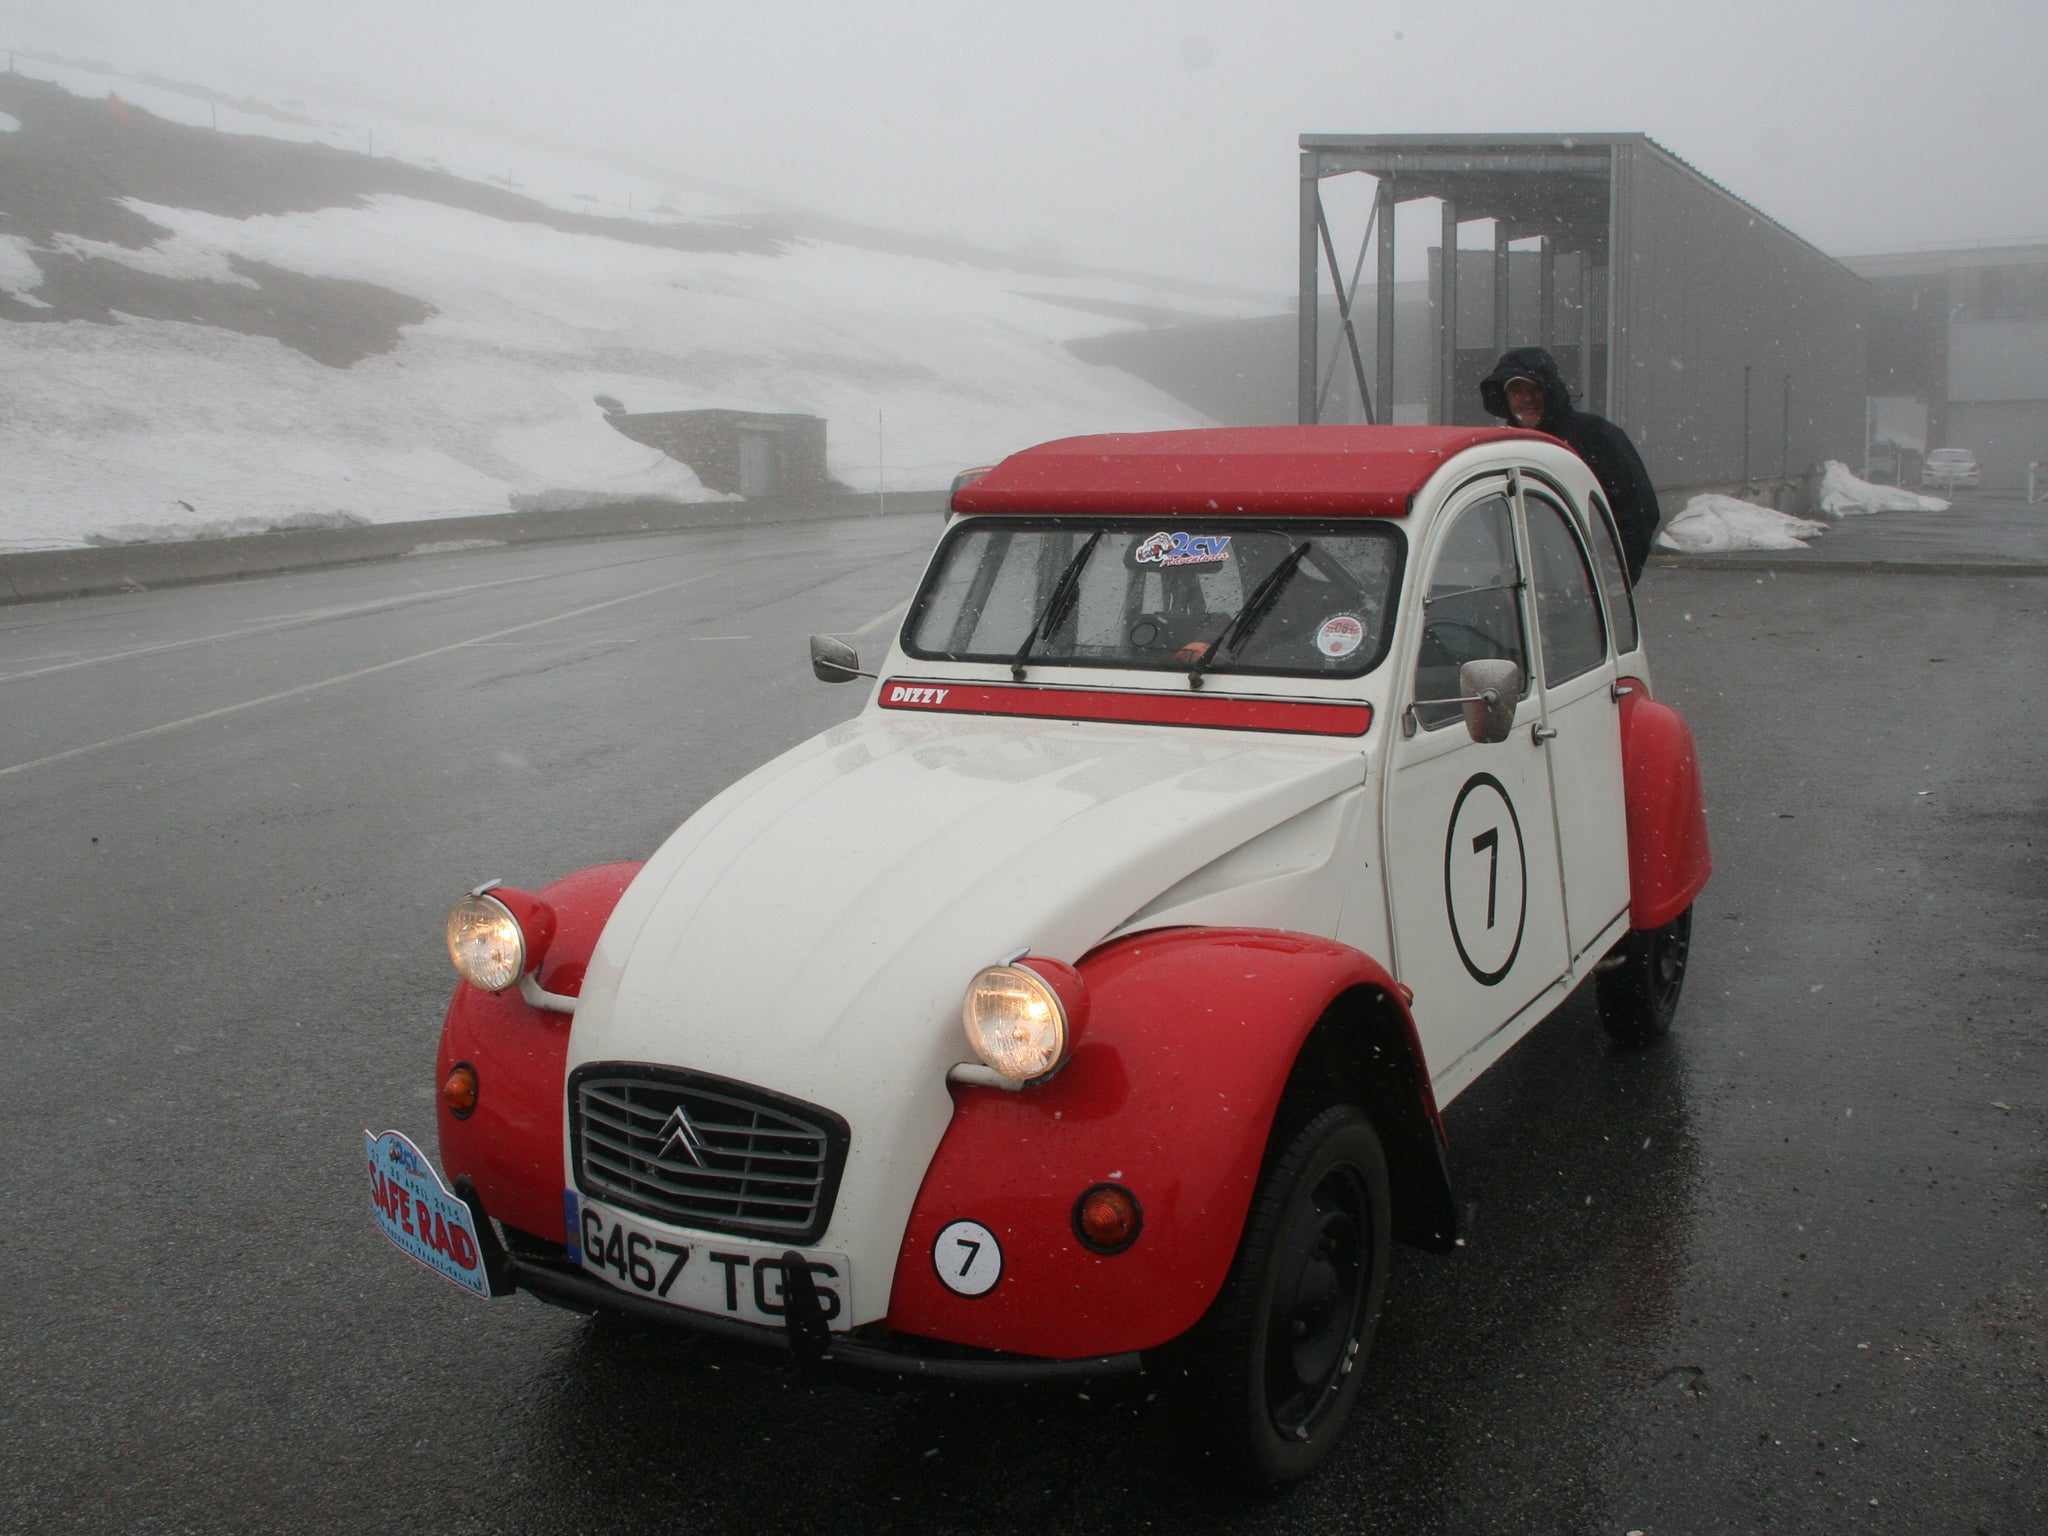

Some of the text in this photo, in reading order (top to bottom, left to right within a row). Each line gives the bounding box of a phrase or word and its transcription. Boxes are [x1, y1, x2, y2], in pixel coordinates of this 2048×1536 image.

[1168, 532, 1231, 556] 2CV
[890, 686, 949, 704] DIZZY
[1472, 826, 1498, 930] 7
[369, 1160, 414, 1236] SAFE
[405, 1179, 429, 1201] APRIL
[581, 1207, 690, 1298] G467
[957, 1238, 981, 1277] 7
